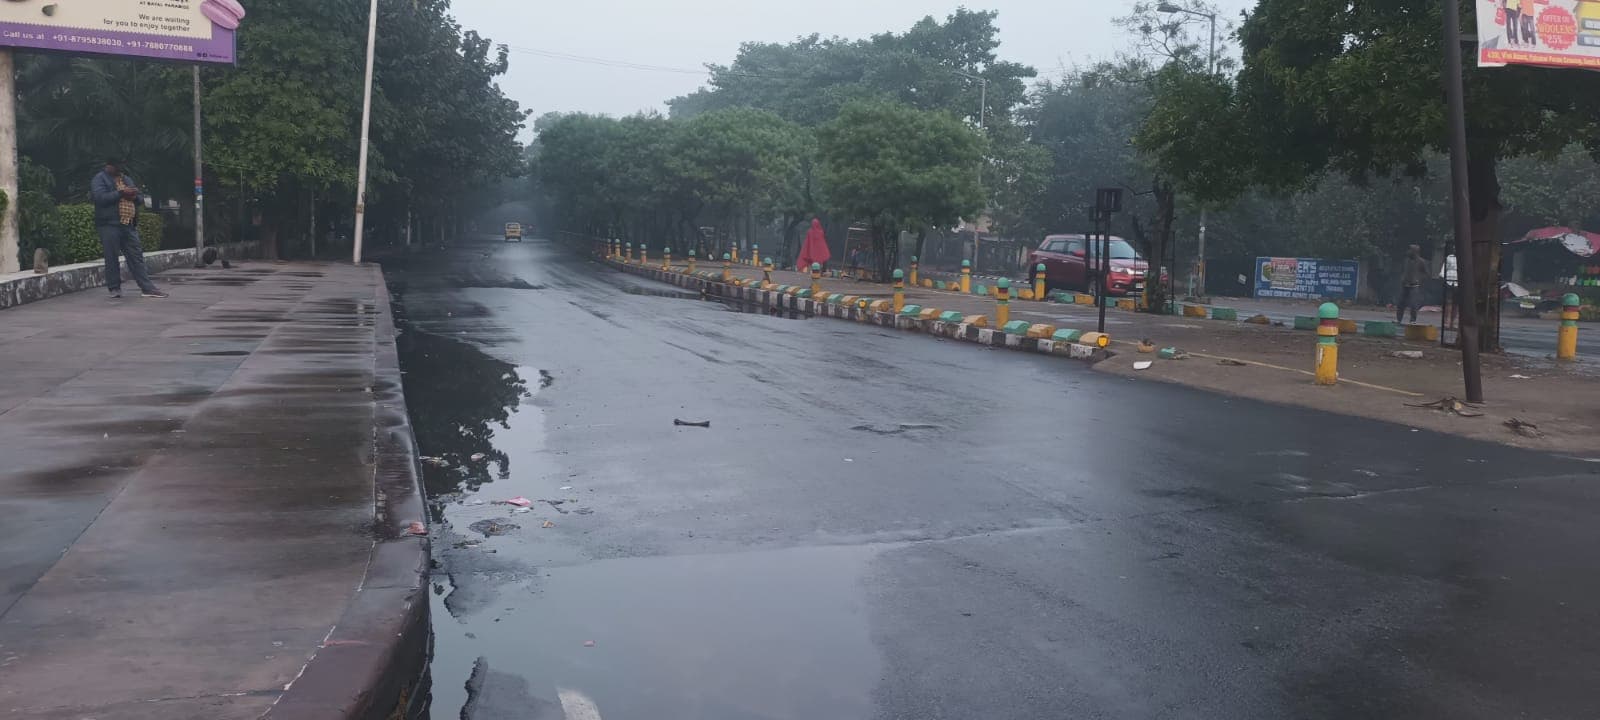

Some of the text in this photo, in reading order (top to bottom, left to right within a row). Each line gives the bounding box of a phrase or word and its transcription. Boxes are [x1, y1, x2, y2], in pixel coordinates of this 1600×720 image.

[165, 17, 190, 25] waiting
[1542, 15, 1561, 23] OFFER
[116, 20, 129, 28] you
[139, 21, 159, 30] enjoy
[160, 24, 190, 32] together
[1538, 23, 1574, 34] WOOLENS
[3, 30, 20, 38] Call
